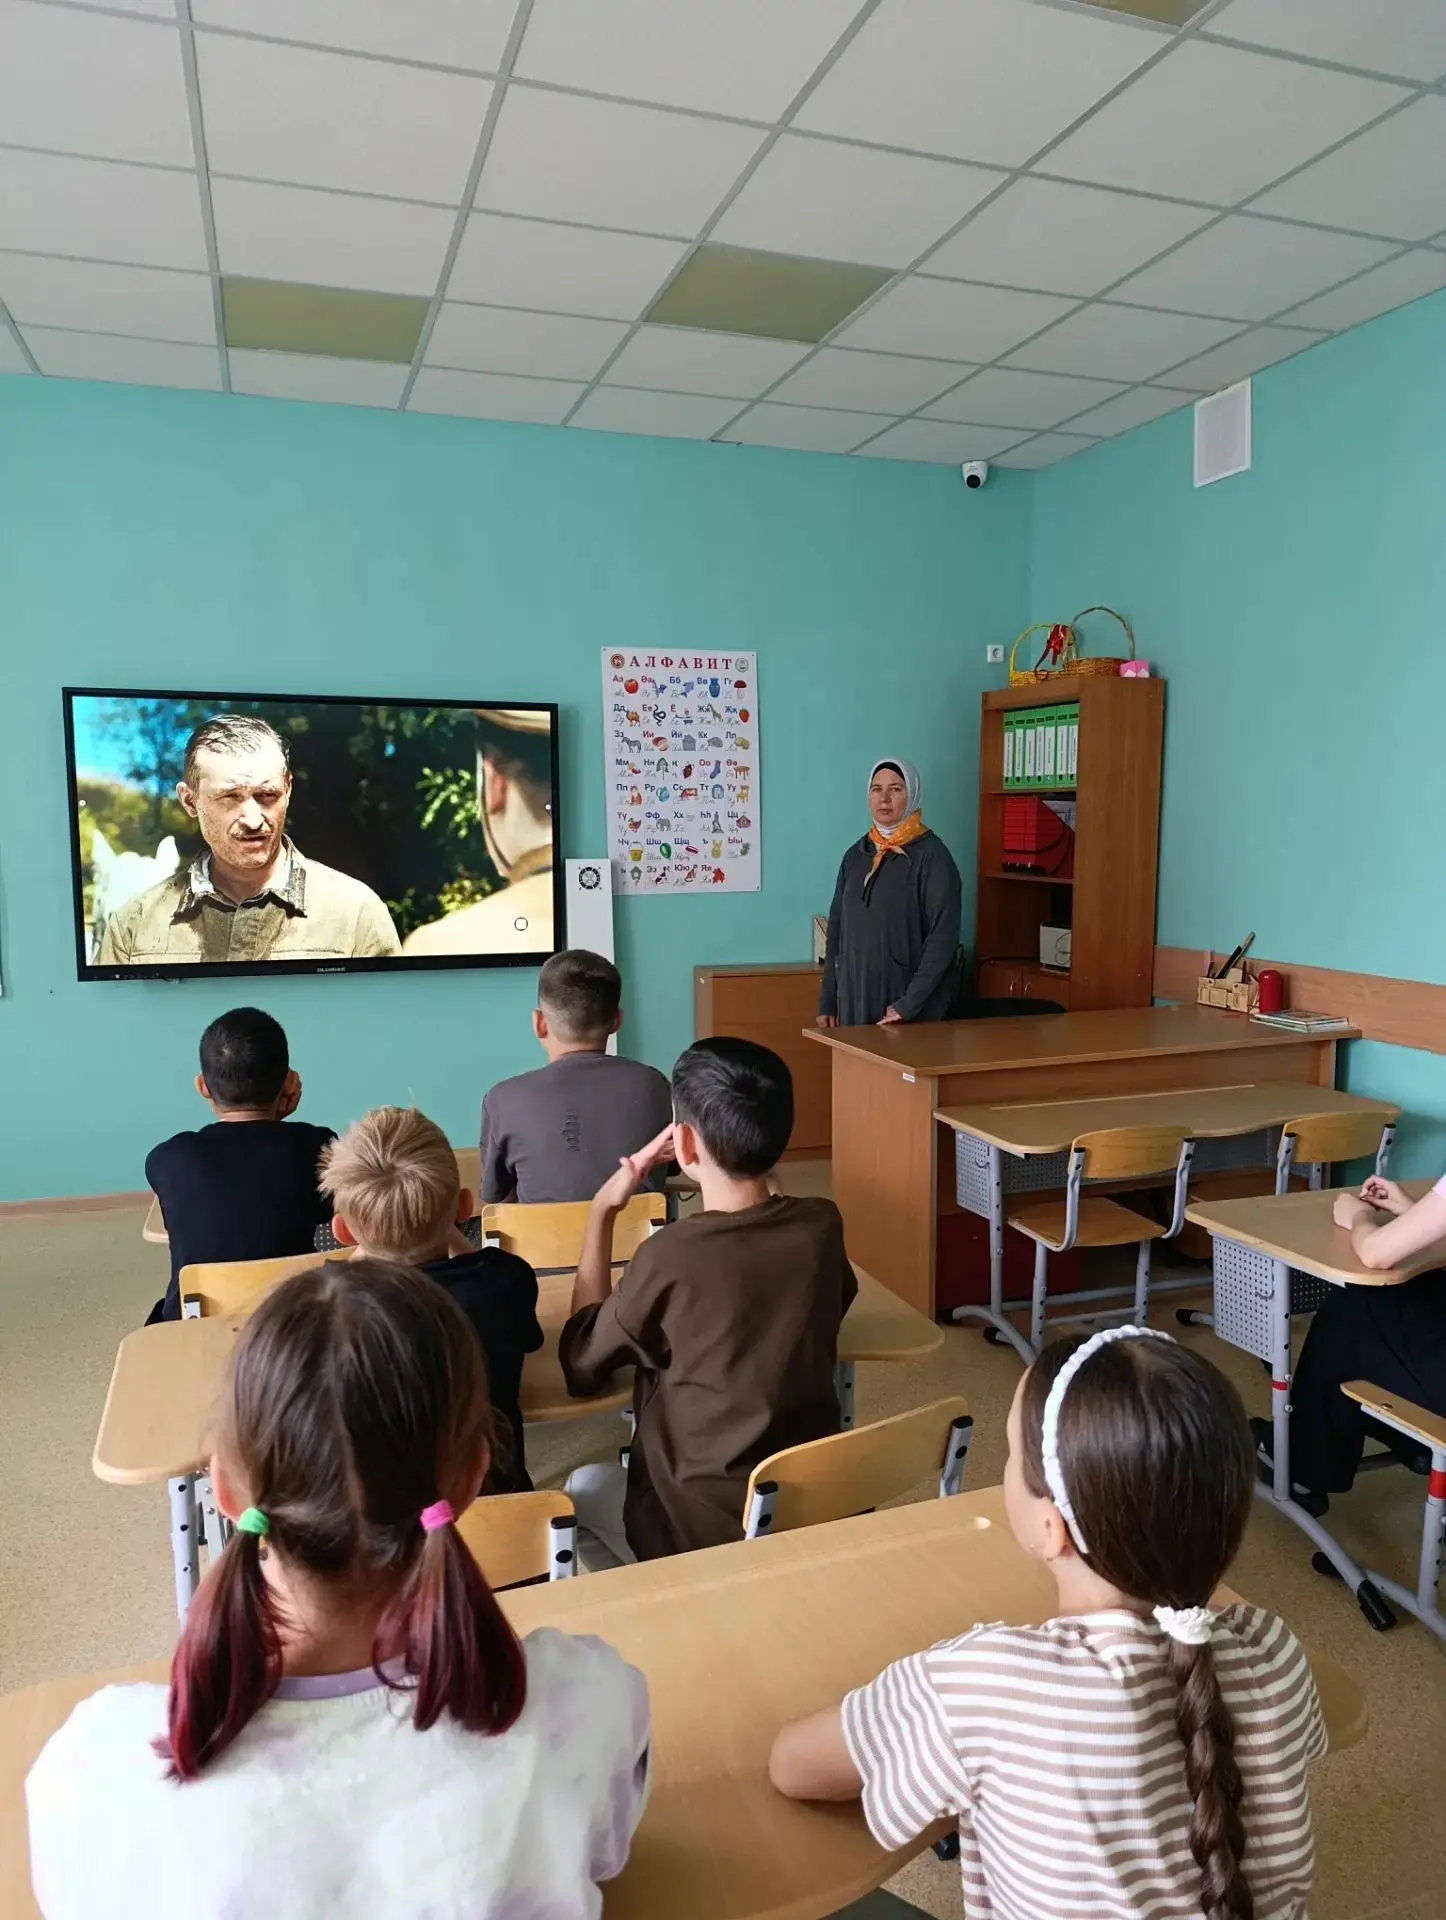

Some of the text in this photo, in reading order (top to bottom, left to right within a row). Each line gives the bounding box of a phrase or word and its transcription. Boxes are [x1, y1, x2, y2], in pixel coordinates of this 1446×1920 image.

[629, 655, 732, 670] АЛФАВИТ
[670, 676, 682, 684] Бб
[613, 703, 626, 712] Дд
[642, 730, 655, 738] Ии
[725, 731, 737, 739] Лл
[645, 784, 656, 792] Рр
[727, 784, 737, 792] Уу
[645, 811, 661, 820] Фф
[727, 811, 739, 819] Цц
[646, 865, 658, 873] Ээ
